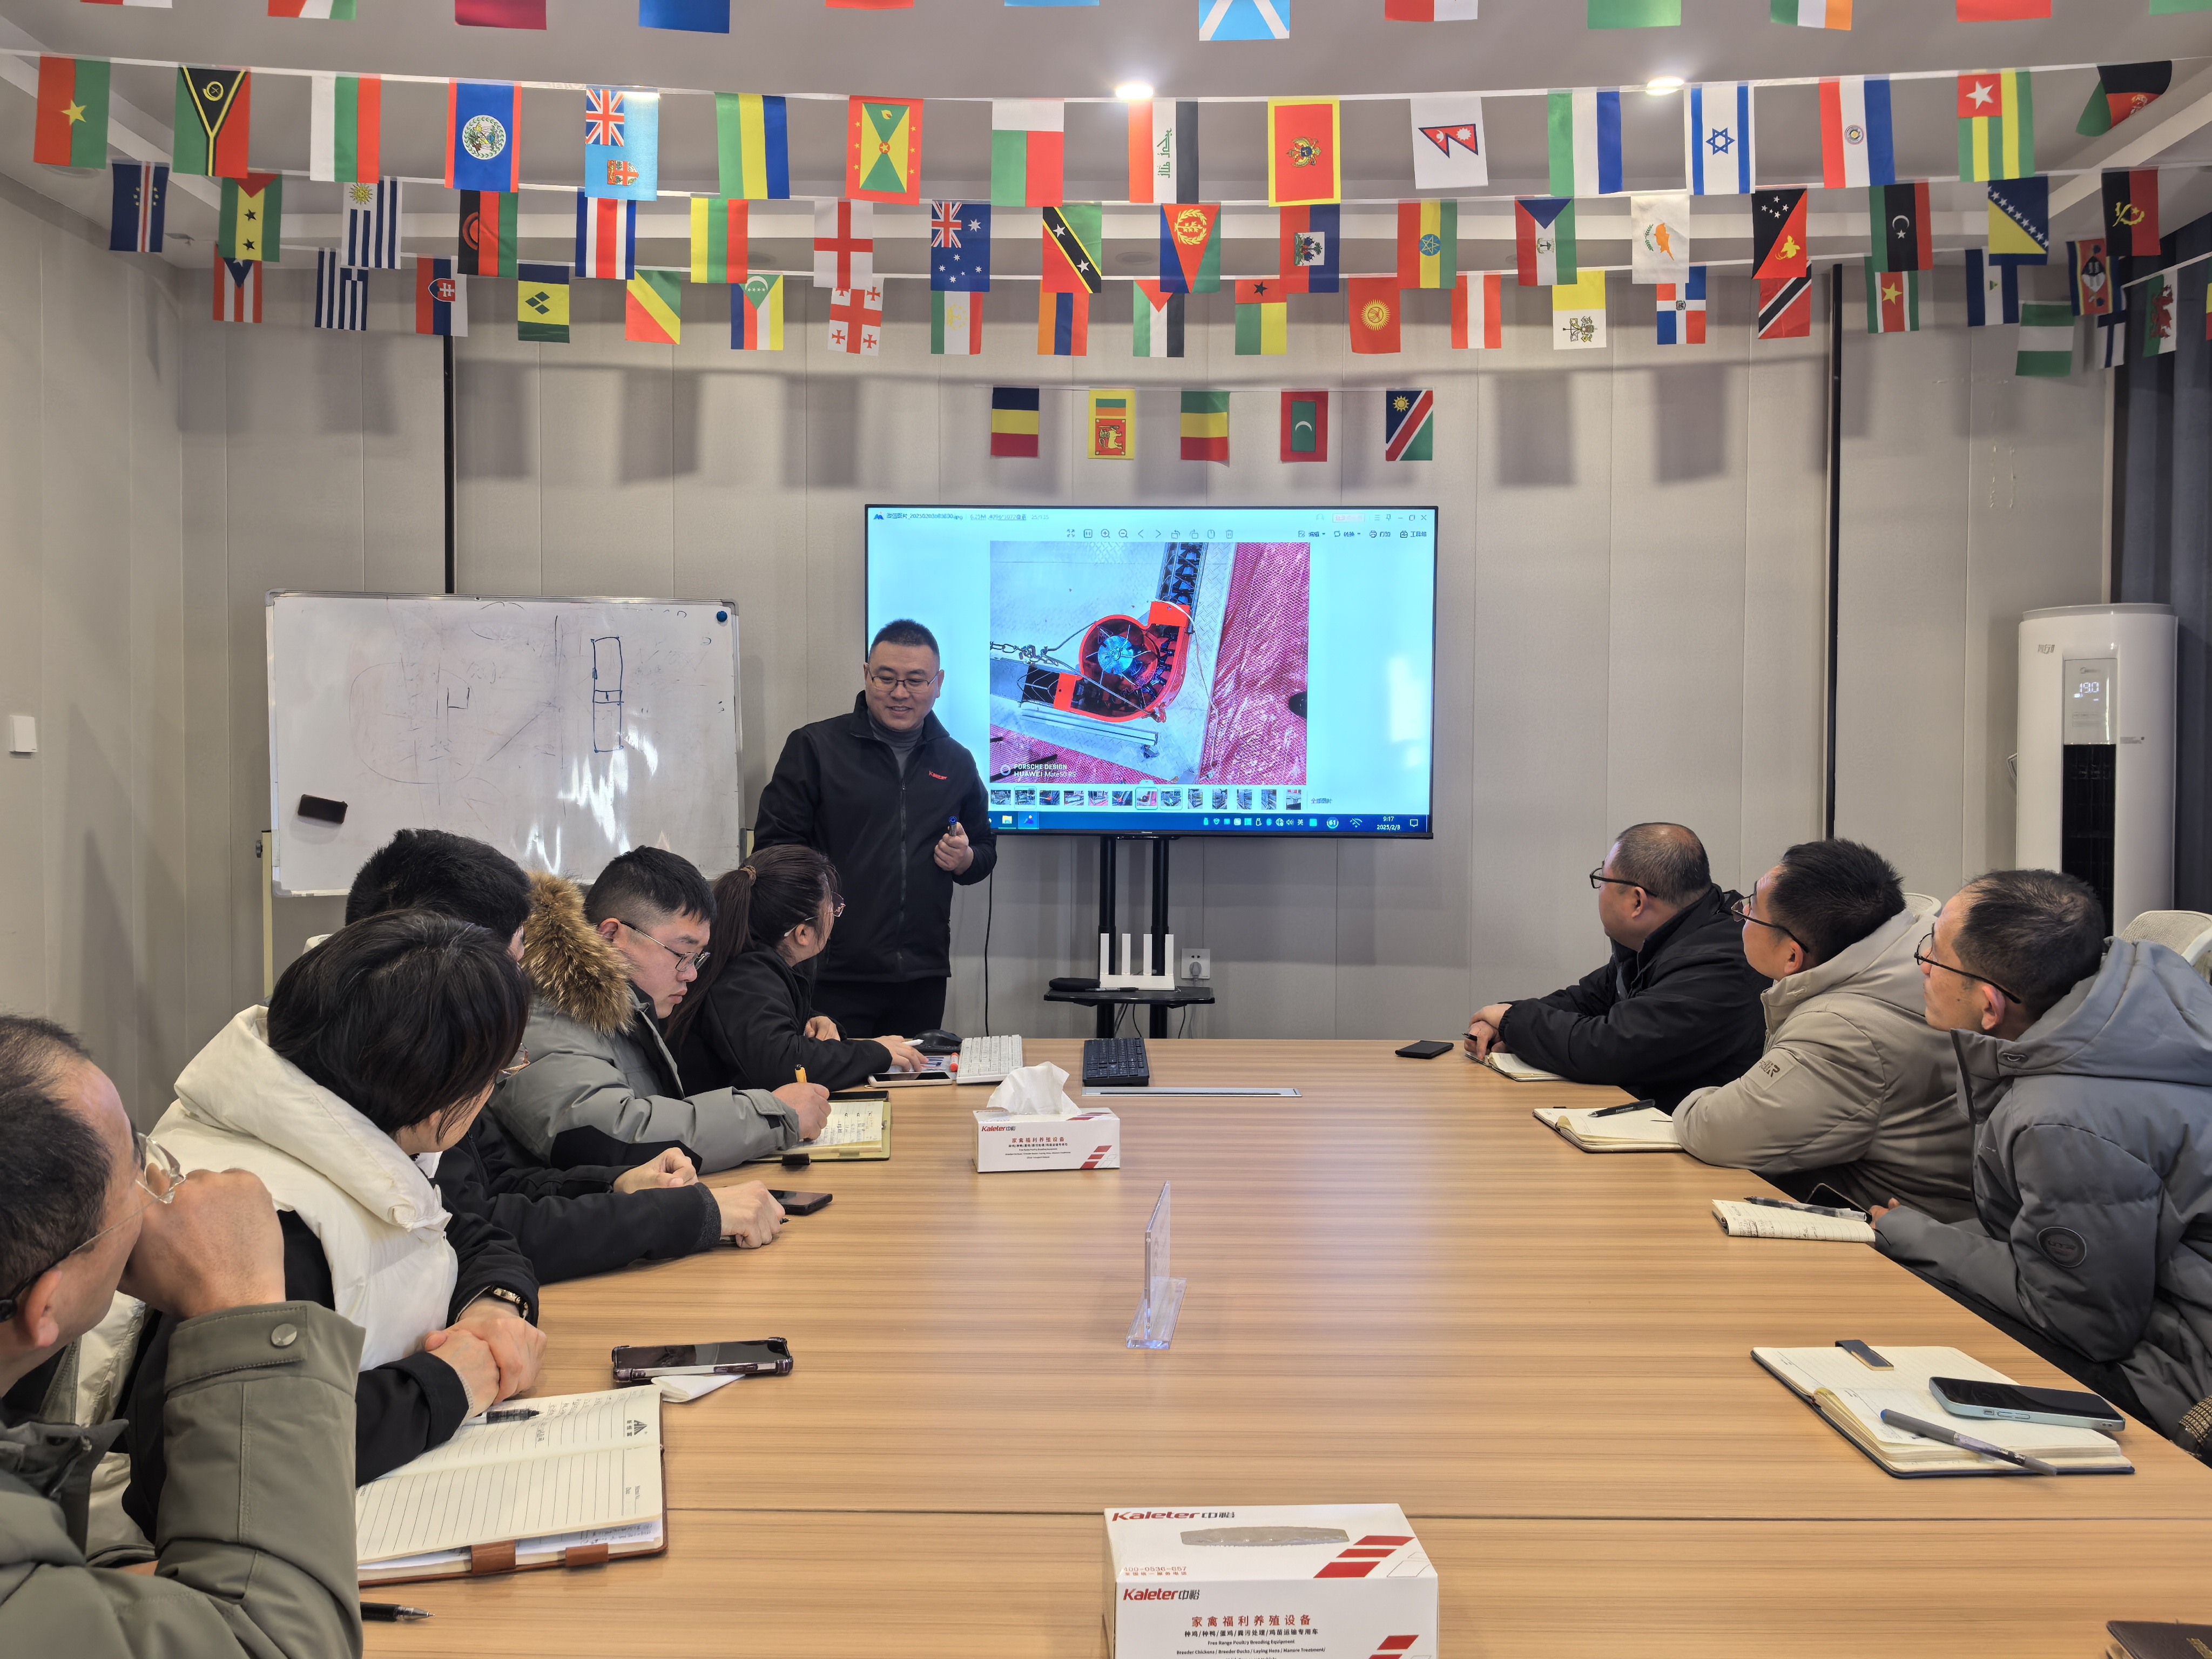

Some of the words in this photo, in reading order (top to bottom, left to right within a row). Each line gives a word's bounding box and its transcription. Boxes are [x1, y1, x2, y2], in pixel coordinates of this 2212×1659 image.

[1112, 1512, 1200, 1521] Kaleter
[1123, 1588, 1178, 1601] Kaleter
[1191, 1614, 1311, 1627] 家禽福利养殖设备
